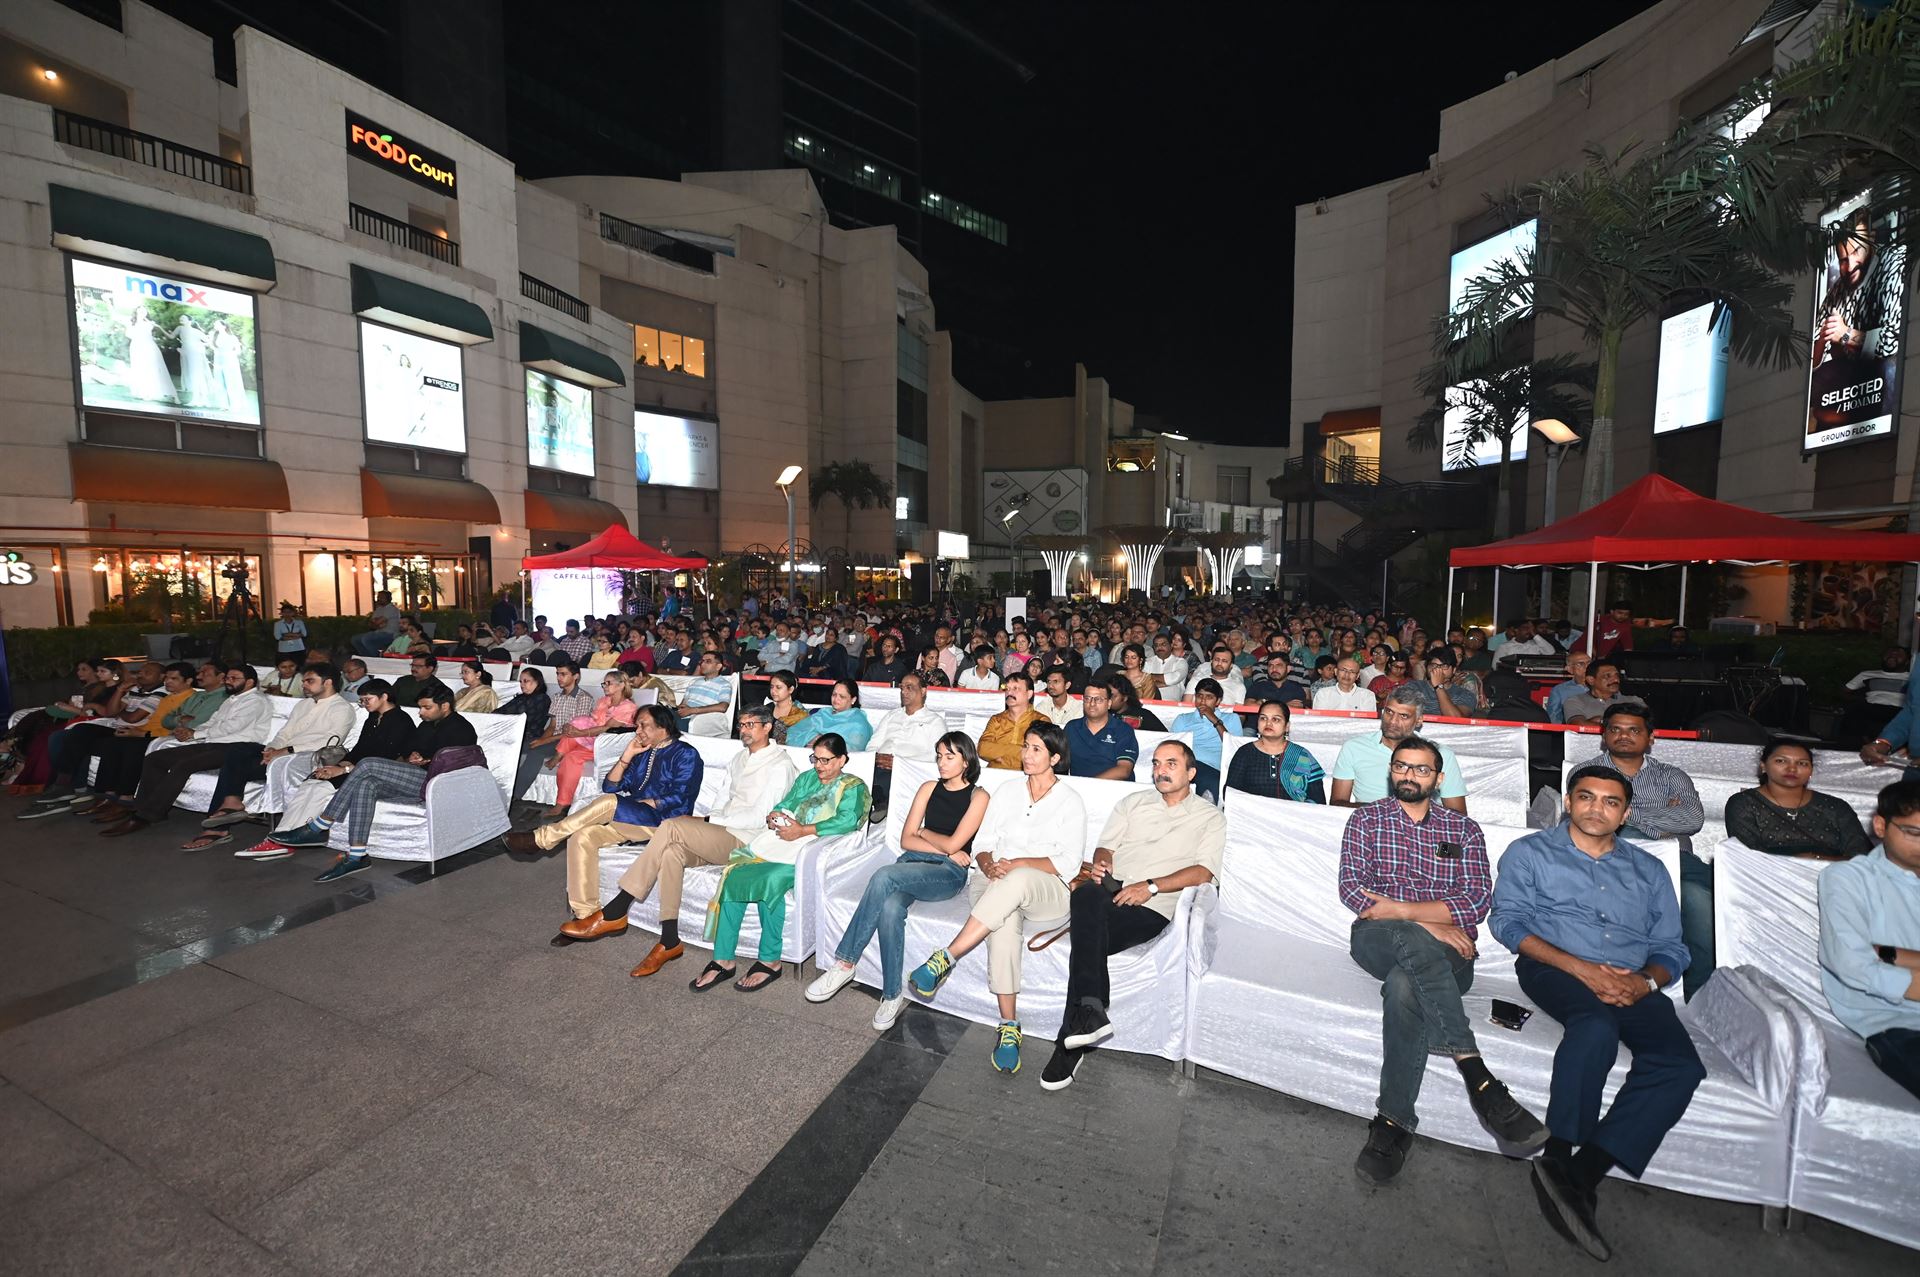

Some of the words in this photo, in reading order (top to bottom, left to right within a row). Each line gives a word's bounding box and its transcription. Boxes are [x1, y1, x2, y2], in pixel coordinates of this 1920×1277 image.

[352, 124, 407, 164] FOOD
[408, 154, 454, 187] Court
[125, 275, 208, 306] max
[1821, 377, 1883, 406] SELECTED
[1843, 393, 1881, 412] HOMME
[1821, 429, 1850, 443] GROUND
[1852, 423, 1876, 435] FLOOR
